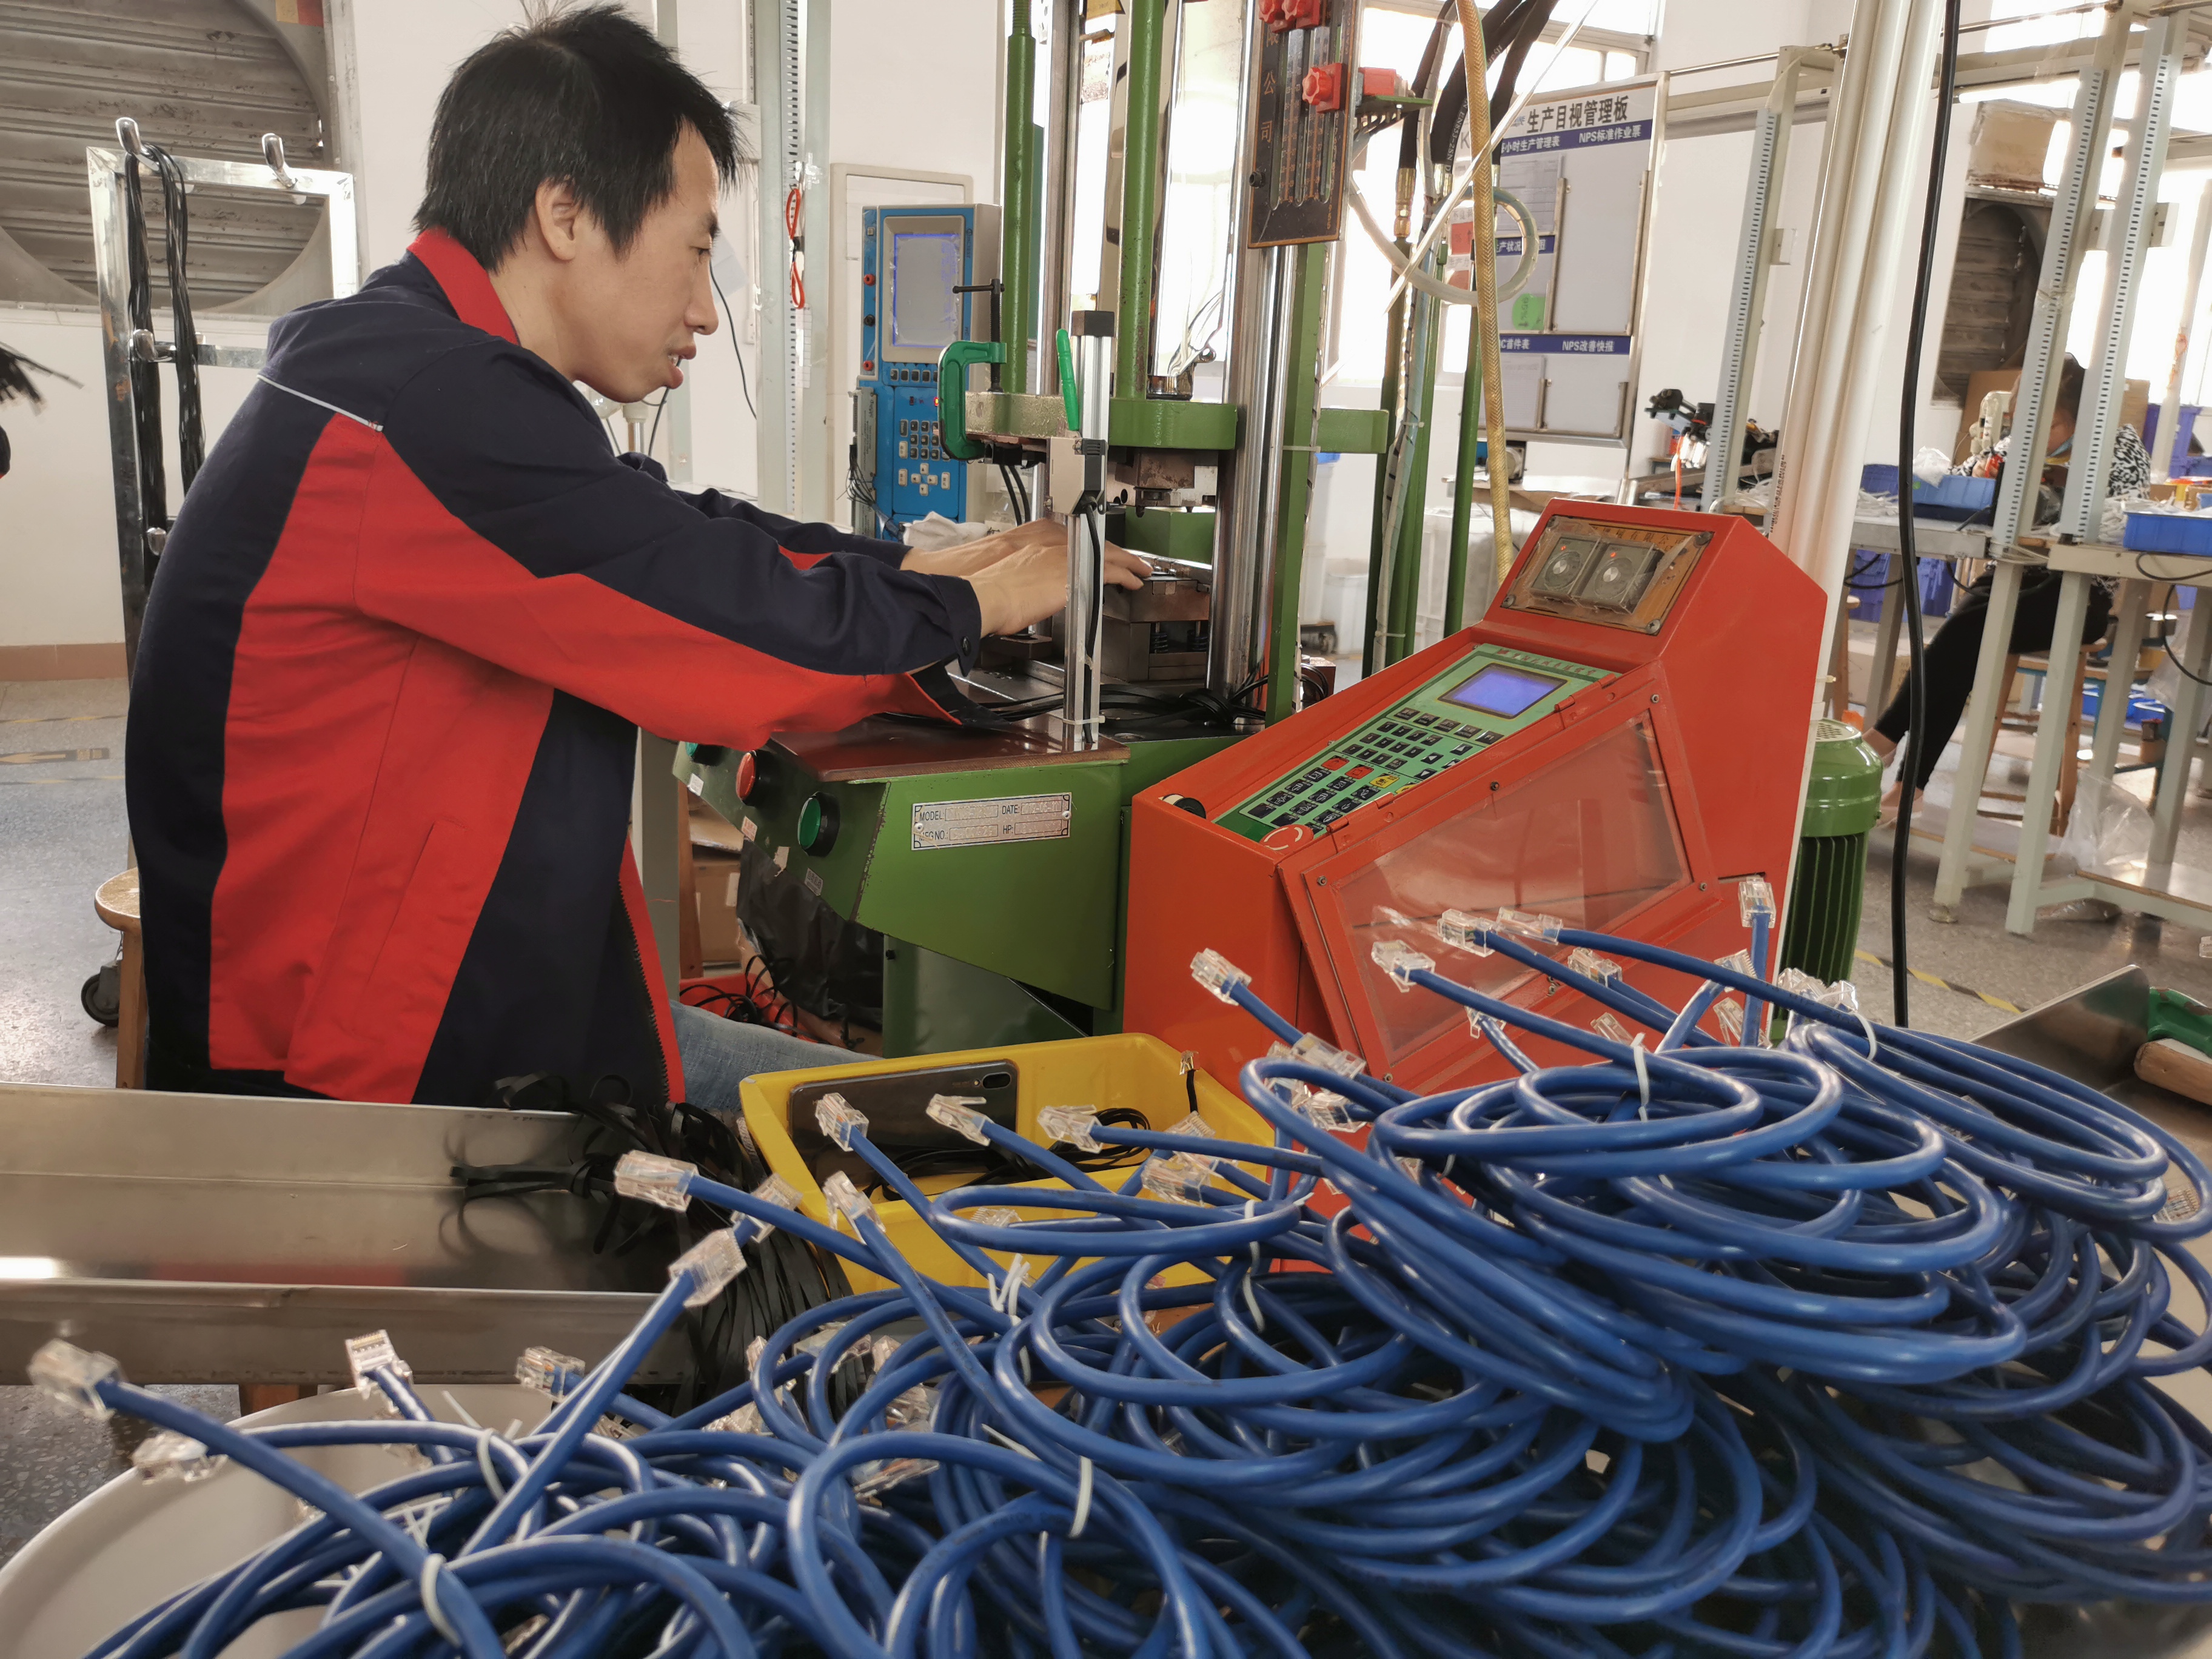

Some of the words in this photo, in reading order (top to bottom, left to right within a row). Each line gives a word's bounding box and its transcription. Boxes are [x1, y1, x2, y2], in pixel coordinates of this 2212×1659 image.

[1527, 95, 1629, 133] 生产目视管理板
[1002, 804, 1020, 814] DATE:
[1003, 825, 1014, 834] HP:
